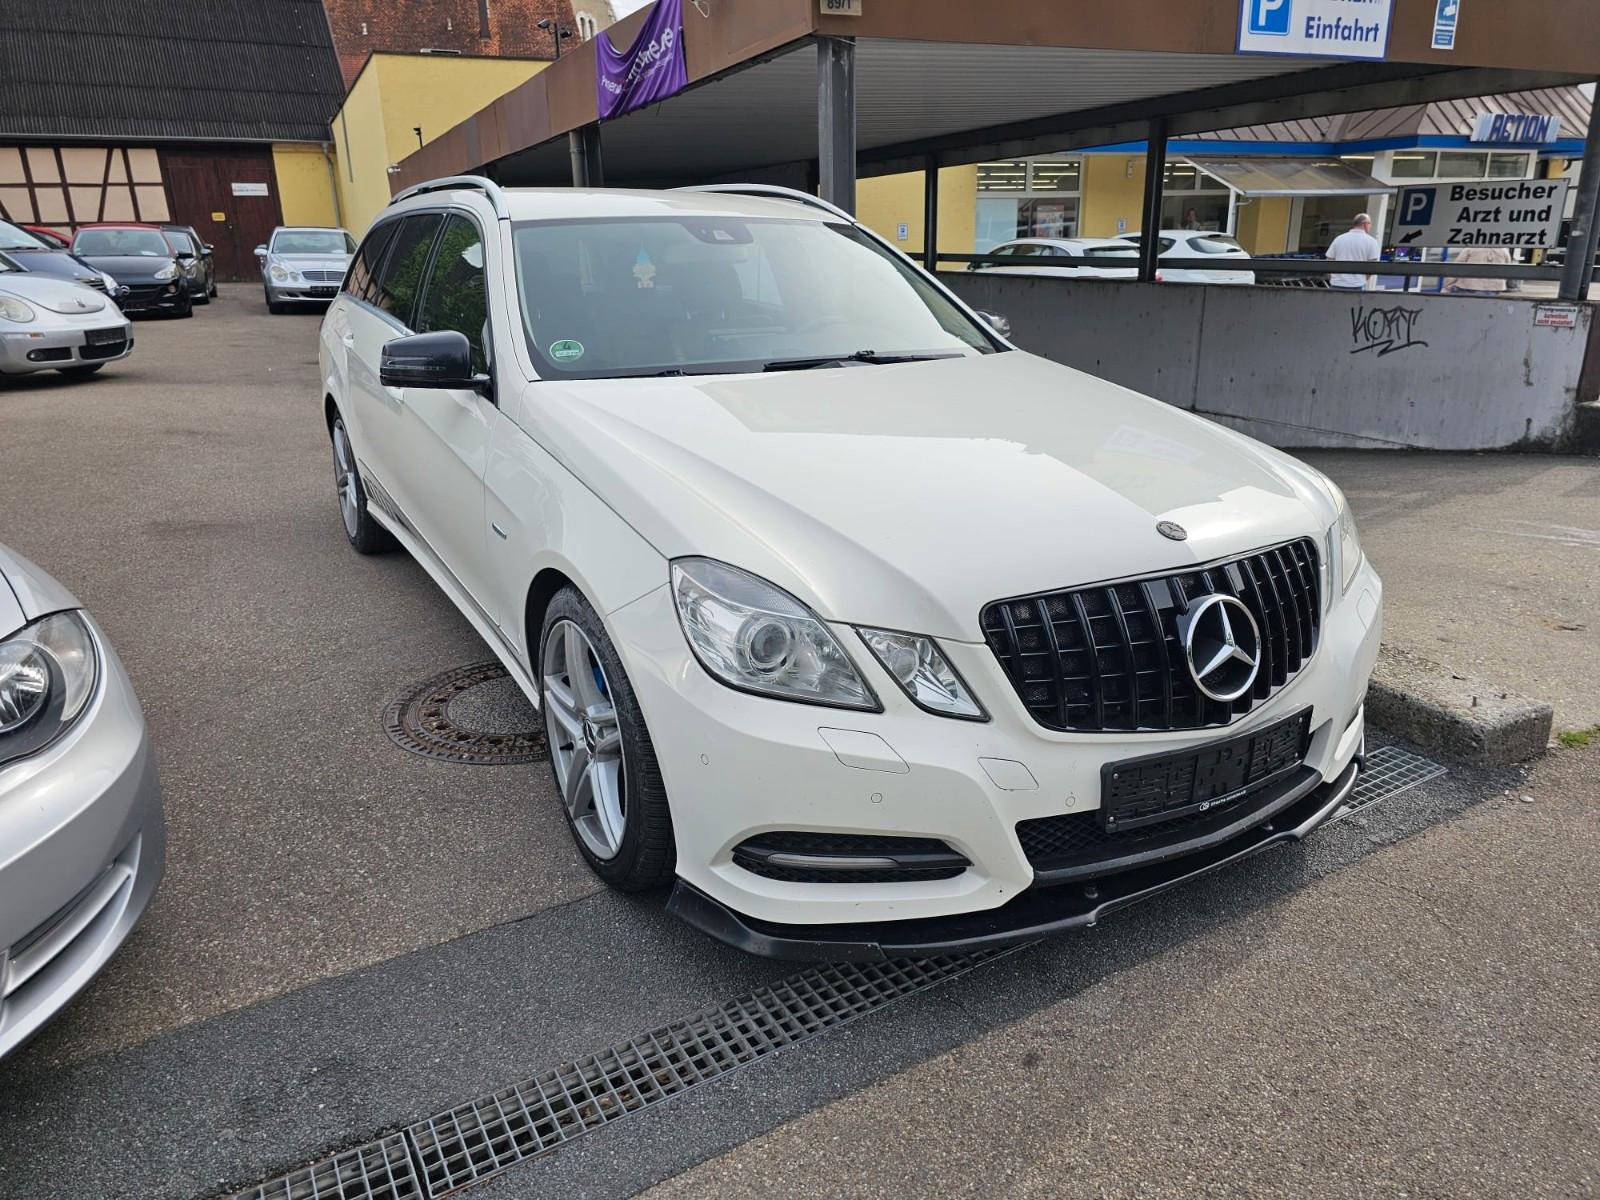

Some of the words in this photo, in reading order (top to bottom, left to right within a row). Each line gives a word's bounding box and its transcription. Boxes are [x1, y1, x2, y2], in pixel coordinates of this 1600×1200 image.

[1305, 16, 1379, 42] Einfahrt
[1490, 114, 1551, 142] ACTION
[1450, 183, 1558, 201] Besucher
[1406, 193, 1427, 221] P
[1456, 207, 1501, 222] Arzt
[1509, 205, 1552, 222] und
[1447, 229, 1547, 245] Zahnarzt
